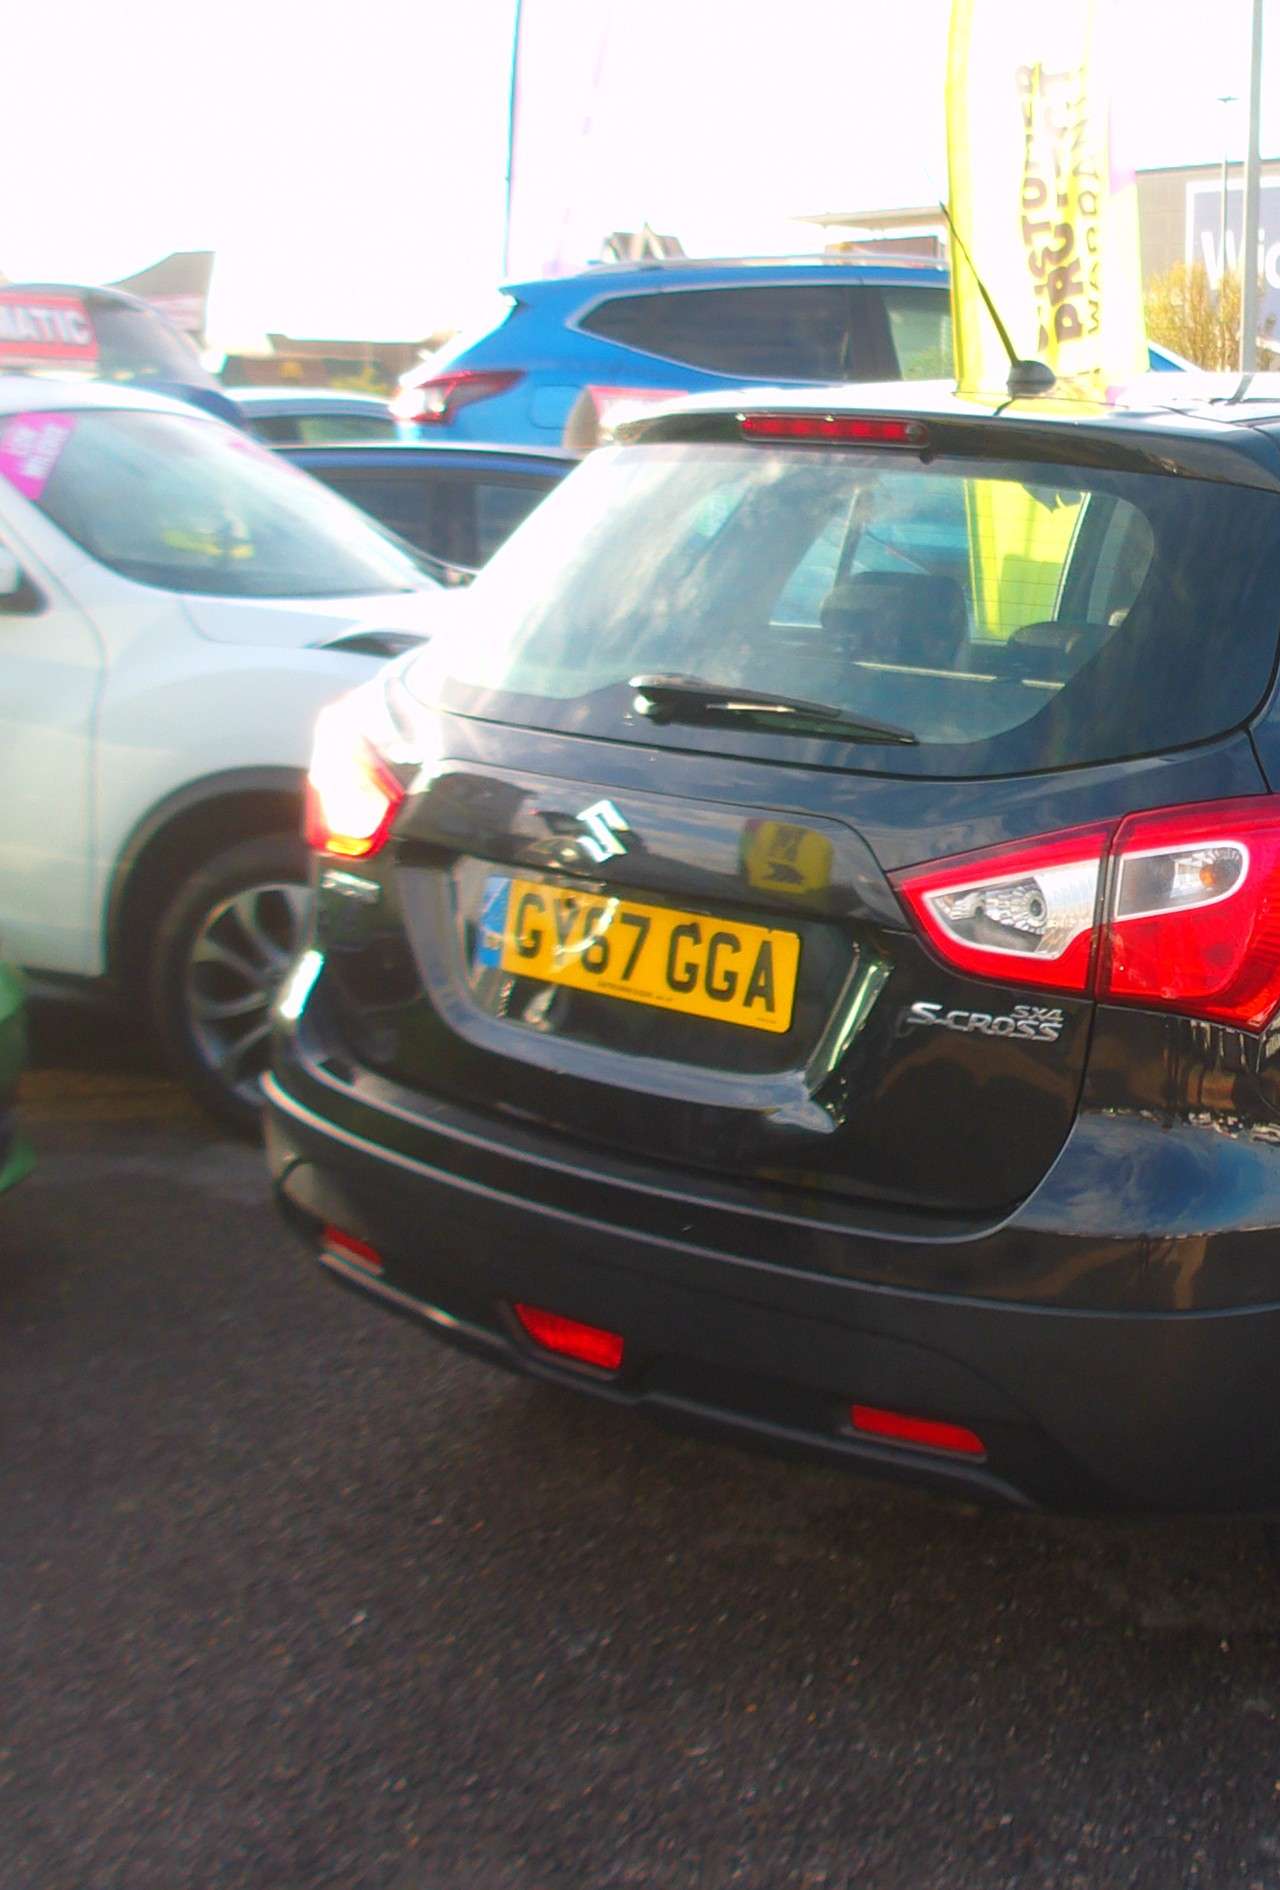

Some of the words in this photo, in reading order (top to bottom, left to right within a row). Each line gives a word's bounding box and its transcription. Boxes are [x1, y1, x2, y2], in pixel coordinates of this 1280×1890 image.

[514, 892, 652, 982] GY67
[665, 921, 776, 1014] GGA
[1010, 1005, 1064, 1022] SX4
